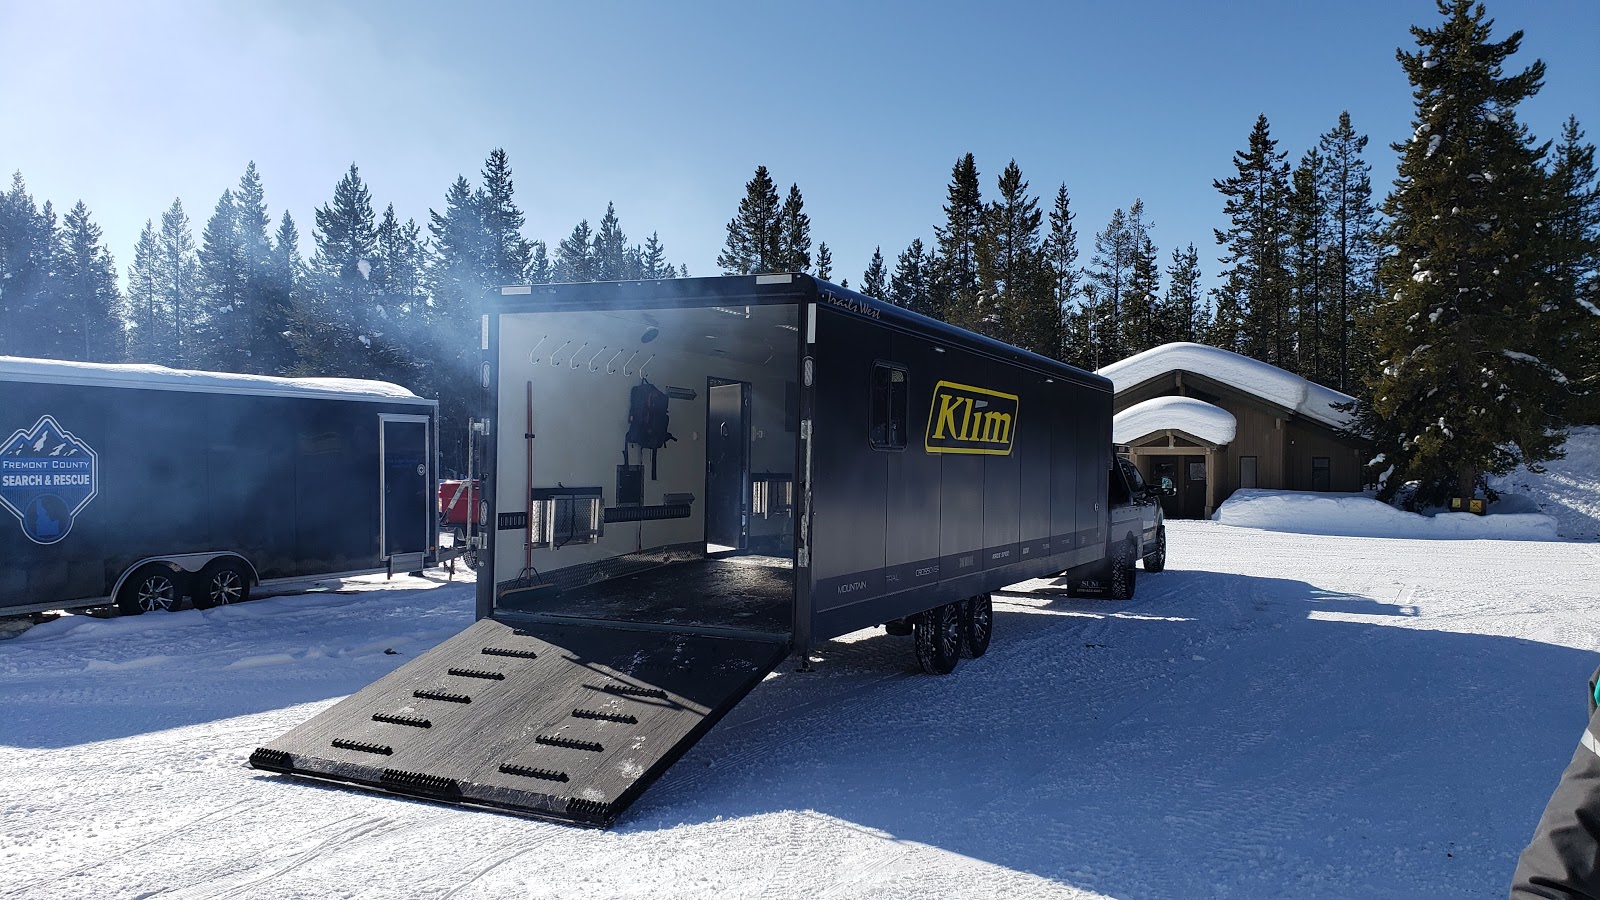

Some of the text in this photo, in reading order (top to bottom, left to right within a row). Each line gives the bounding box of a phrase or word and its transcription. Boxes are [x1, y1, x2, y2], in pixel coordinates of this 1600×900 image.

[825, 289, 880, 319] Trails West
[932, 394, 1011, 443] Klim
[3, 460, 90, 469] FREMONT COUNTY
[2, 474, 90, 486] SEARCH & RESCUE
[837, 580, 867, 594] MOUNTAIN
